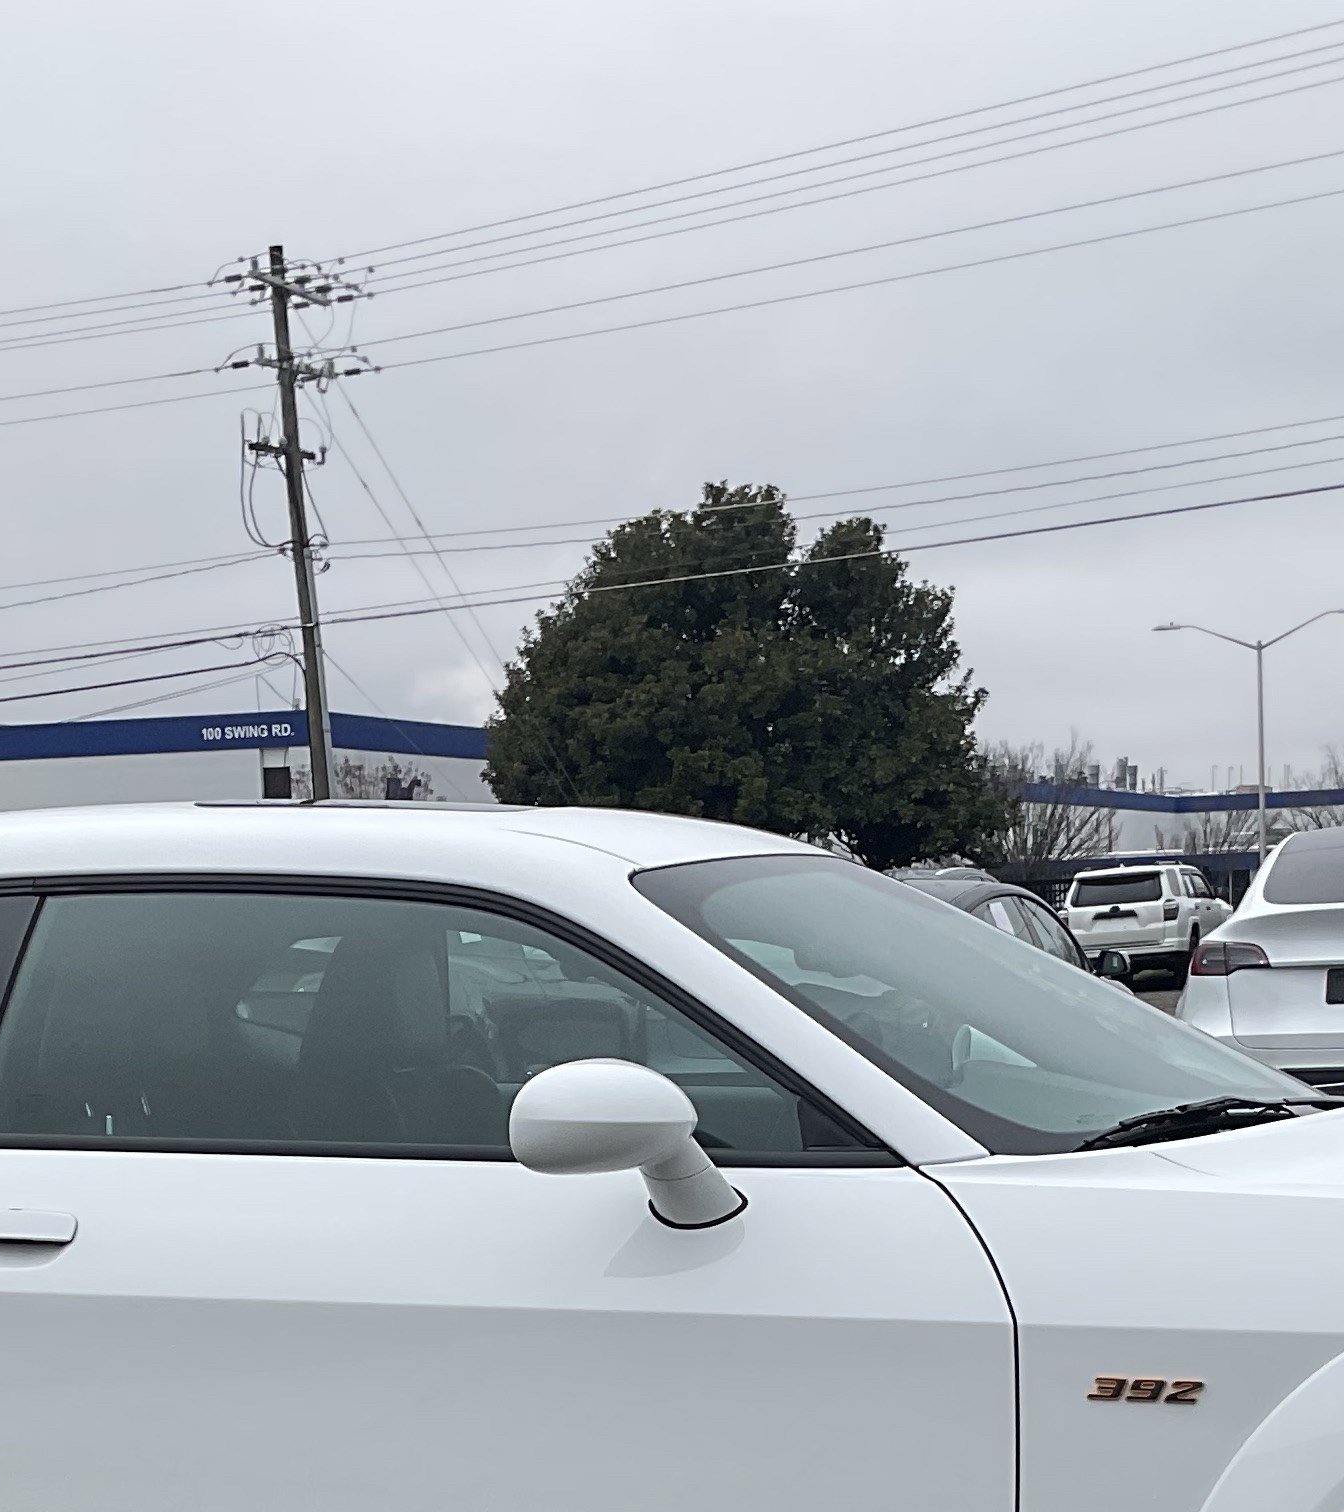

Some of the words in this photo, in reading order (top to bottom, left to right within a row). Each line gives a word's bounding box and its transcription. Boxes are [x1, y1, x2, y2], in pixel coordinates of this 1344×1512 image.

[201, 727, 222, 741] 100
[224, 724, 269, 740] SWING
[271, 723, 295, 737] RD.
[1086, 1376, 1205, 1405] 392
